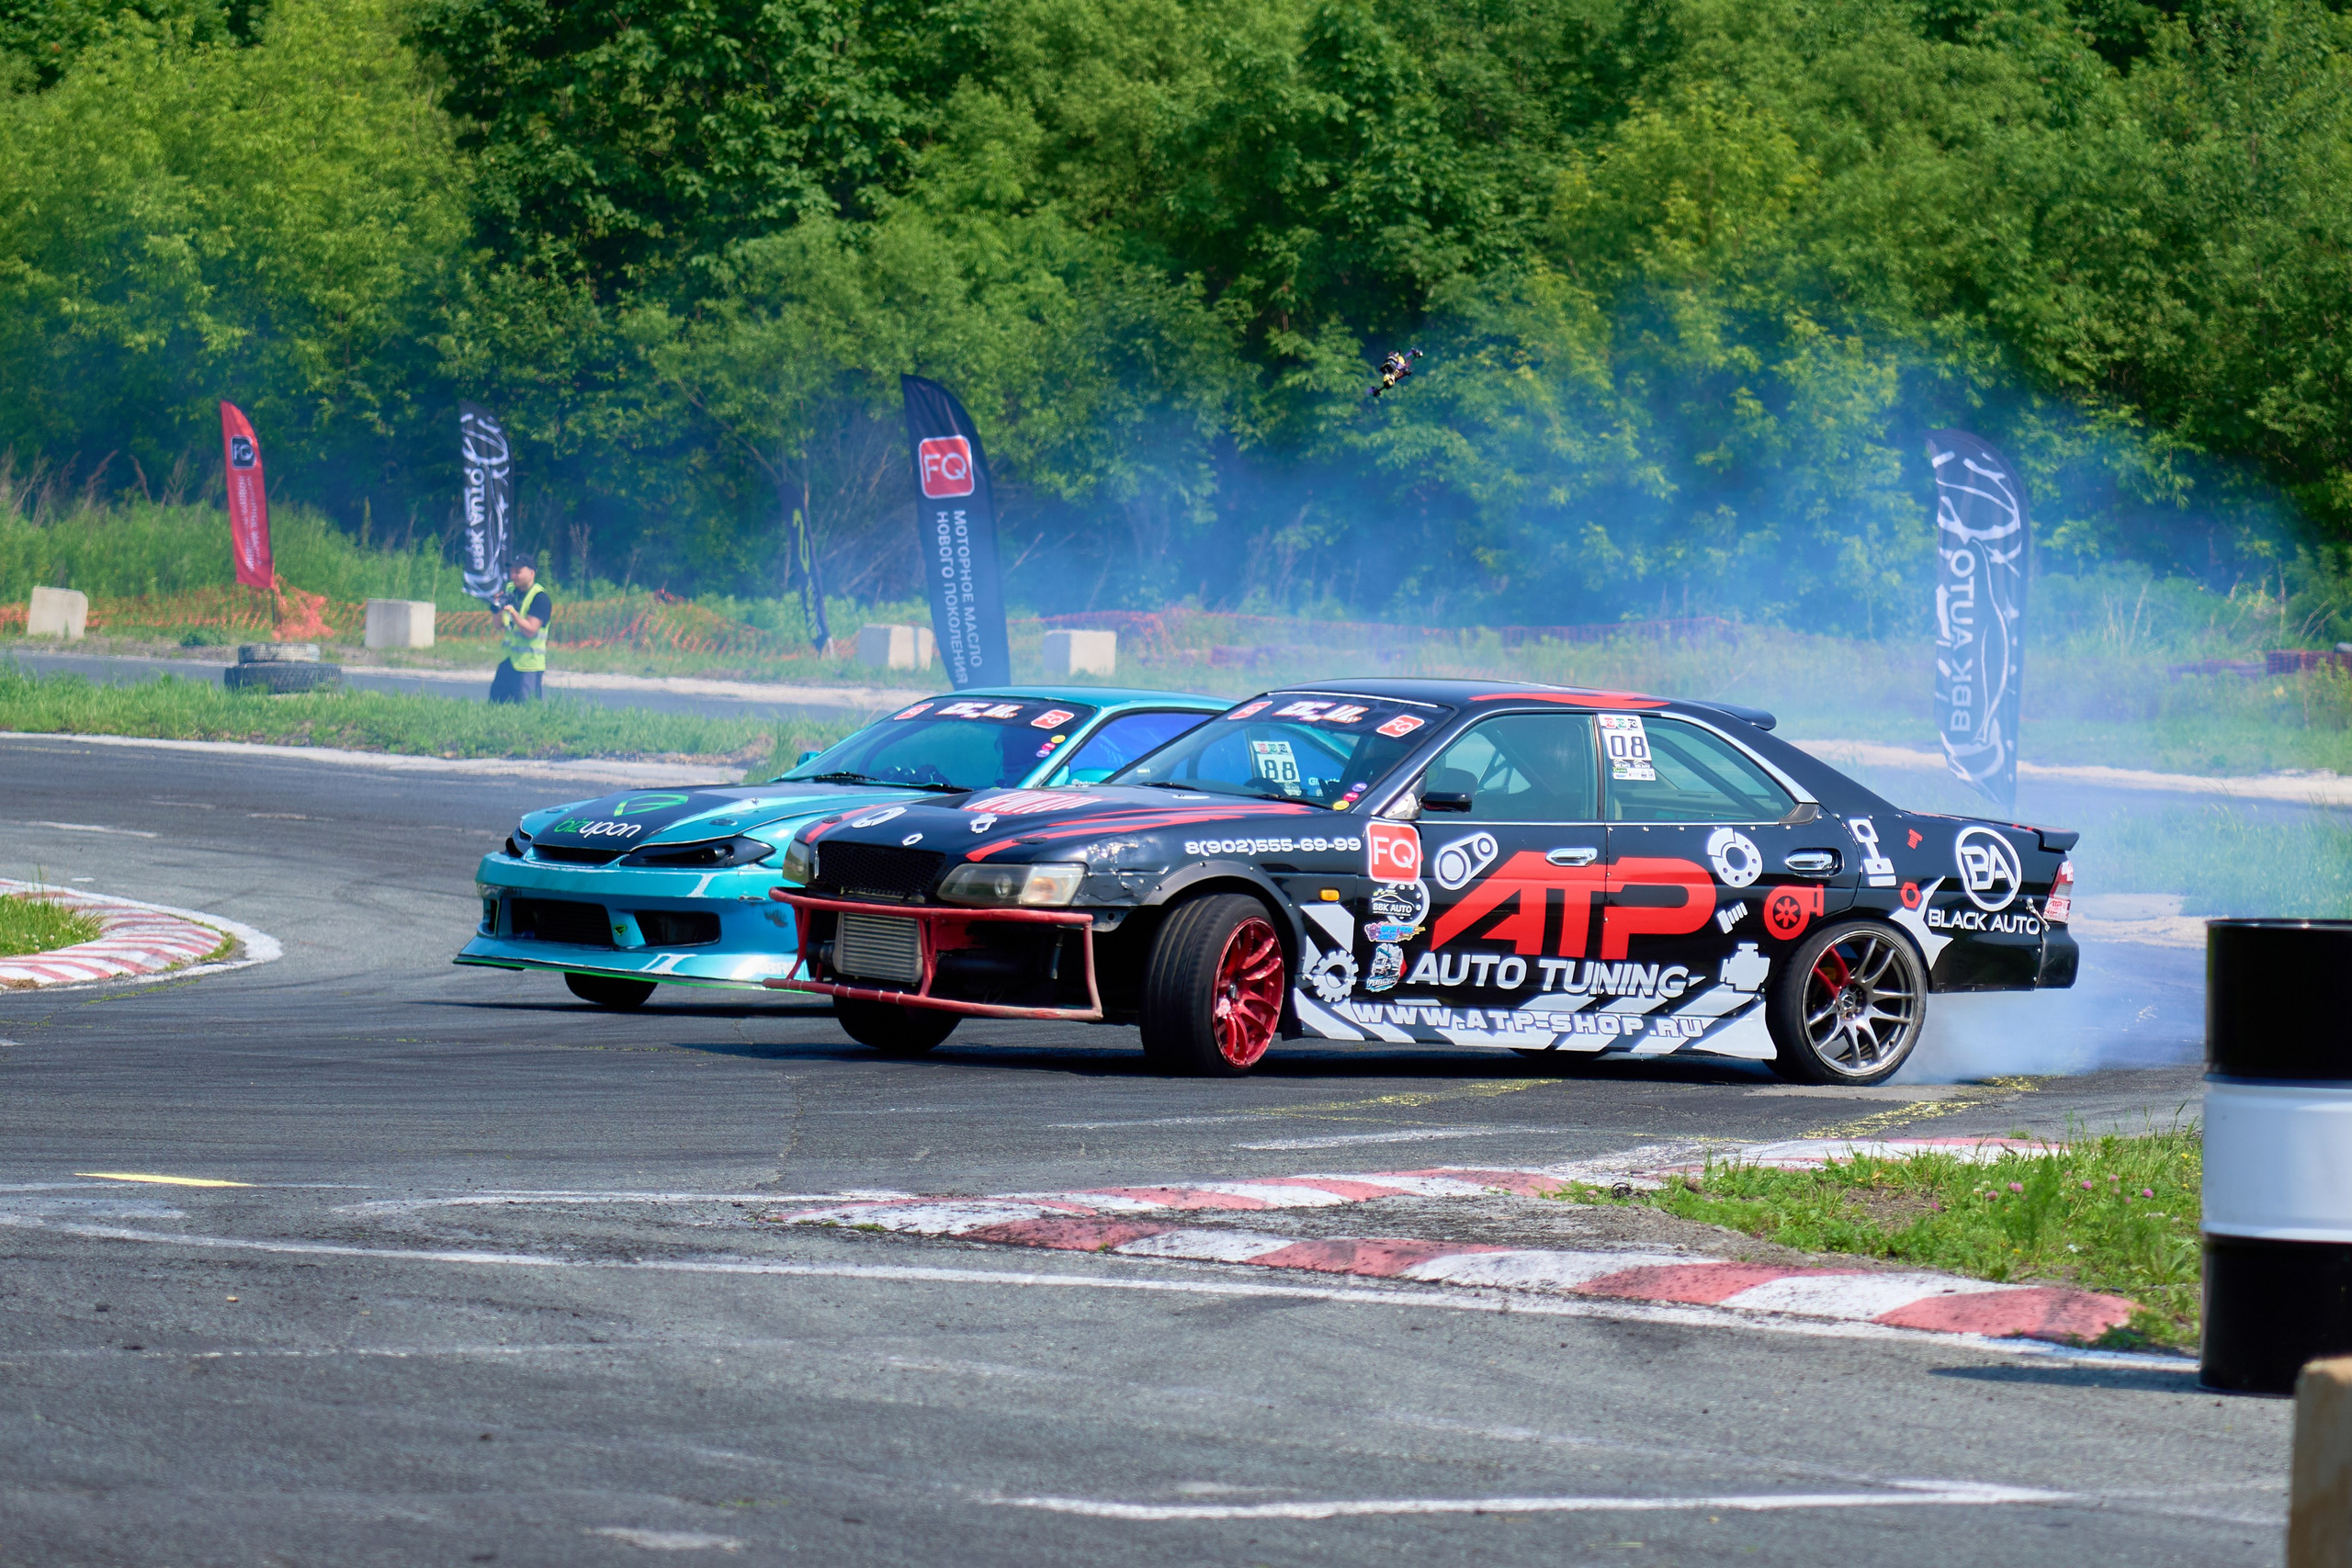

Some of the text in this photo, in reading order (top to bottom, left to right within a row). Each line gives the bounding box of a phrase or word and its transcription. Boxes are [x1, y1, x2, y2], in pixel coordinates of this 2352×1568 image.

[923, 452, 967, 483] FQ
[937, 511, 969, 685] НОВОГО ПОКОЛЕНИЯ
[954, 509, 983, 669] МОТОРНОЕ МАСЛО
[1385, 719, 1416, 733] FQ
[1610, 735, 1647, 758] 08
[1184, 837, 1363, 856] 8(902)555-69-99
[1373, 837, 1417, 869] FQ
[1373, 903, 1389, 912] BBK
[1390, 904, 1413, 914] AUTO
[1430, 851, 1717, 961] ATP
[1928, 908, 2041, 936] BLACK AUTO
[1407, 952, 1690, 998] AUTO TUNING
